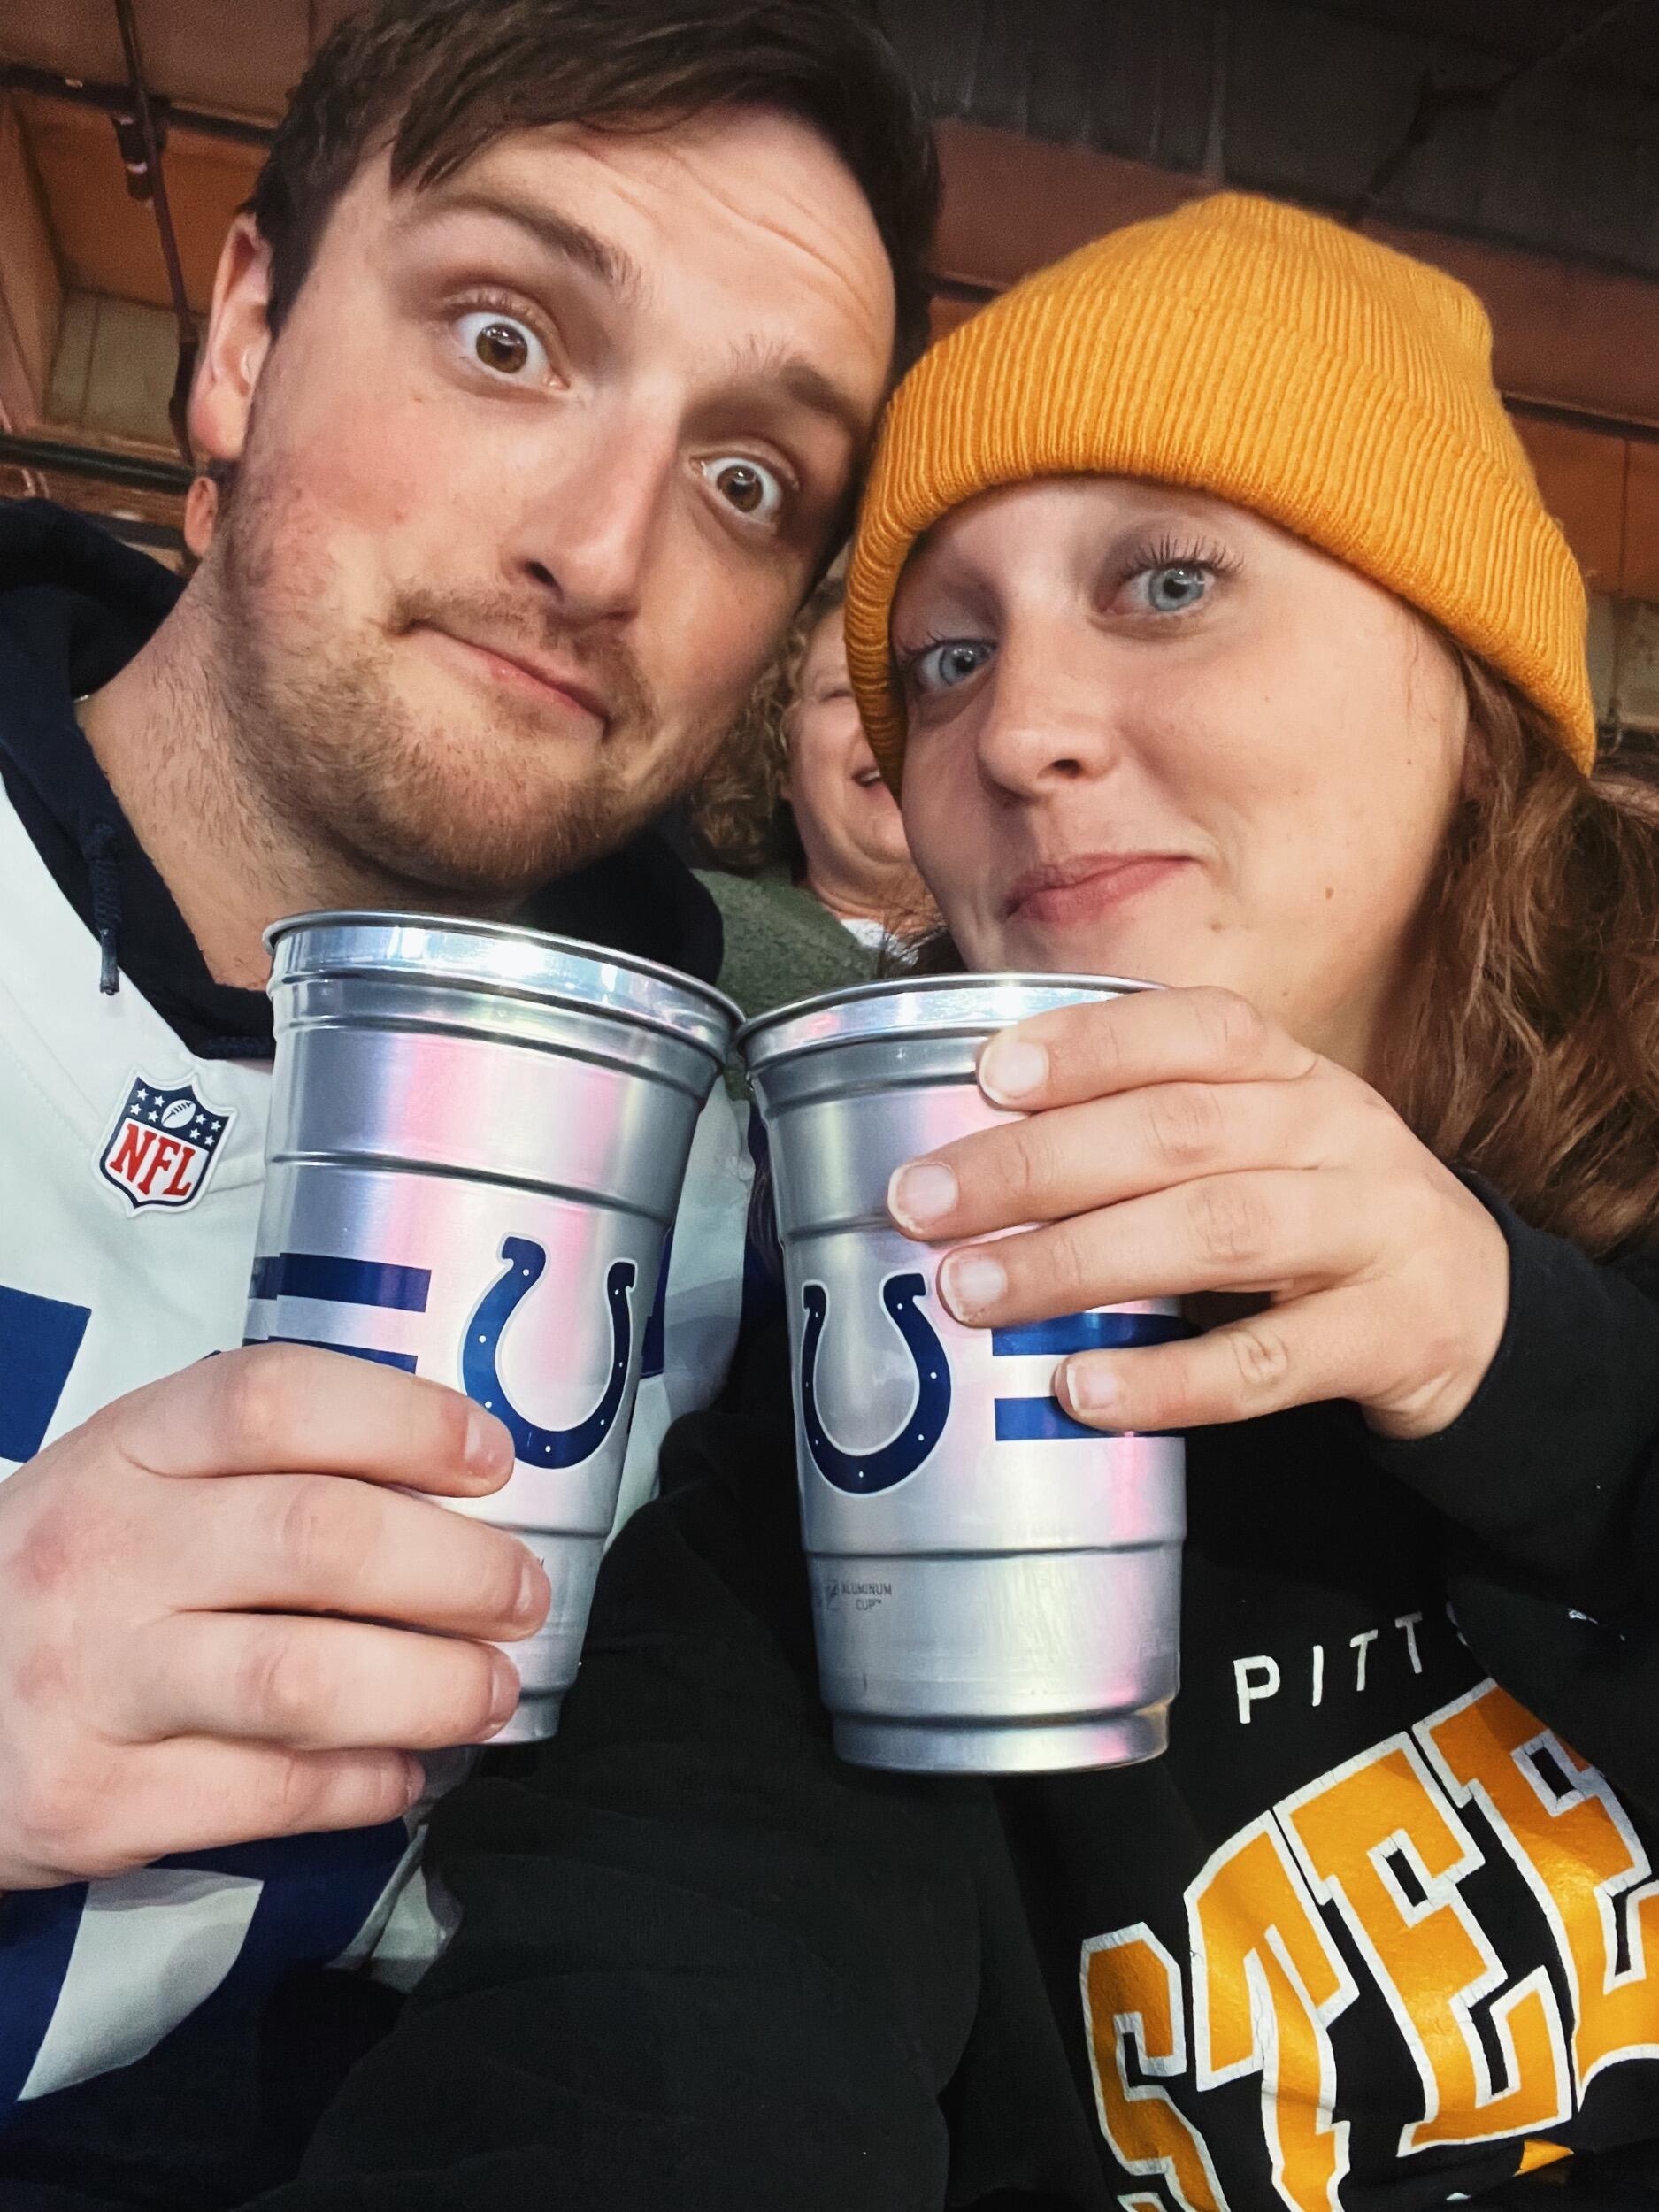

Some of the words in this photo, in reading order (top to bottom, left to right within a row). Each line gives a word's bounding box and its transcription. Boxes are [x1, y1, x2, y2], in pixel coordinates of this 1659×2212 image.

[109, 1122, 196, 1197] NFL
[841, 1581, 892, 1595] ALUMINUM
[1233, 1600, 1472, 1724] PITT
